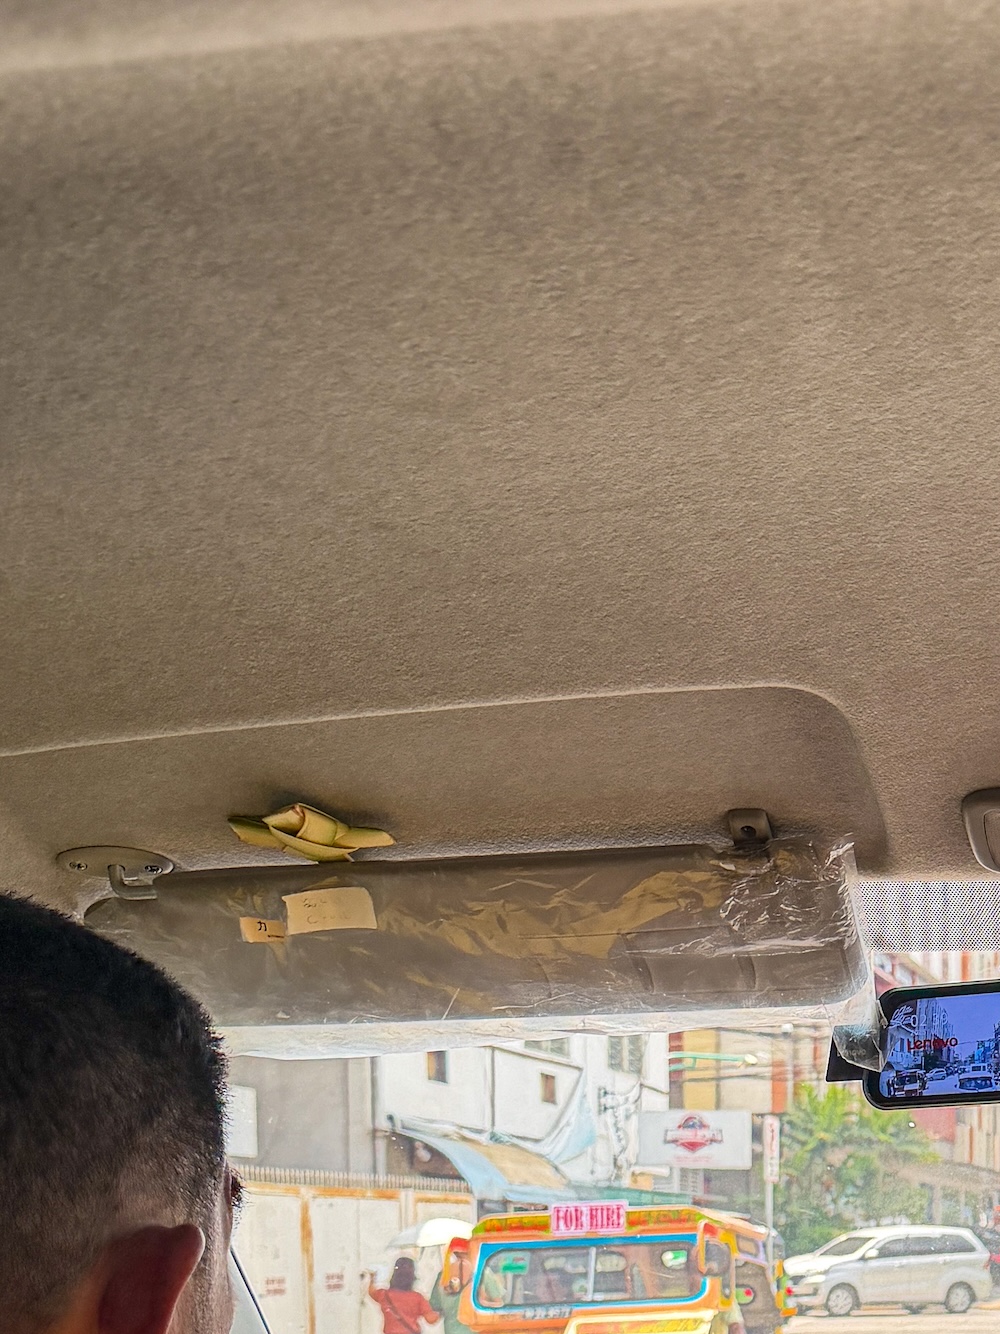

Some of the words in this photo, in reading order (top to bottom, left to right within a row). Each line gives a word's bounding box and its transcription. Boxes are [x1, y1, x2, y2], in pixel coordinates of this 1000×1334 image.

[907, 1037, 958, 1051] Lenovo
[556, 1207, 584, 1231] FOR
[589, 1204, 624, 1230] HIRE
